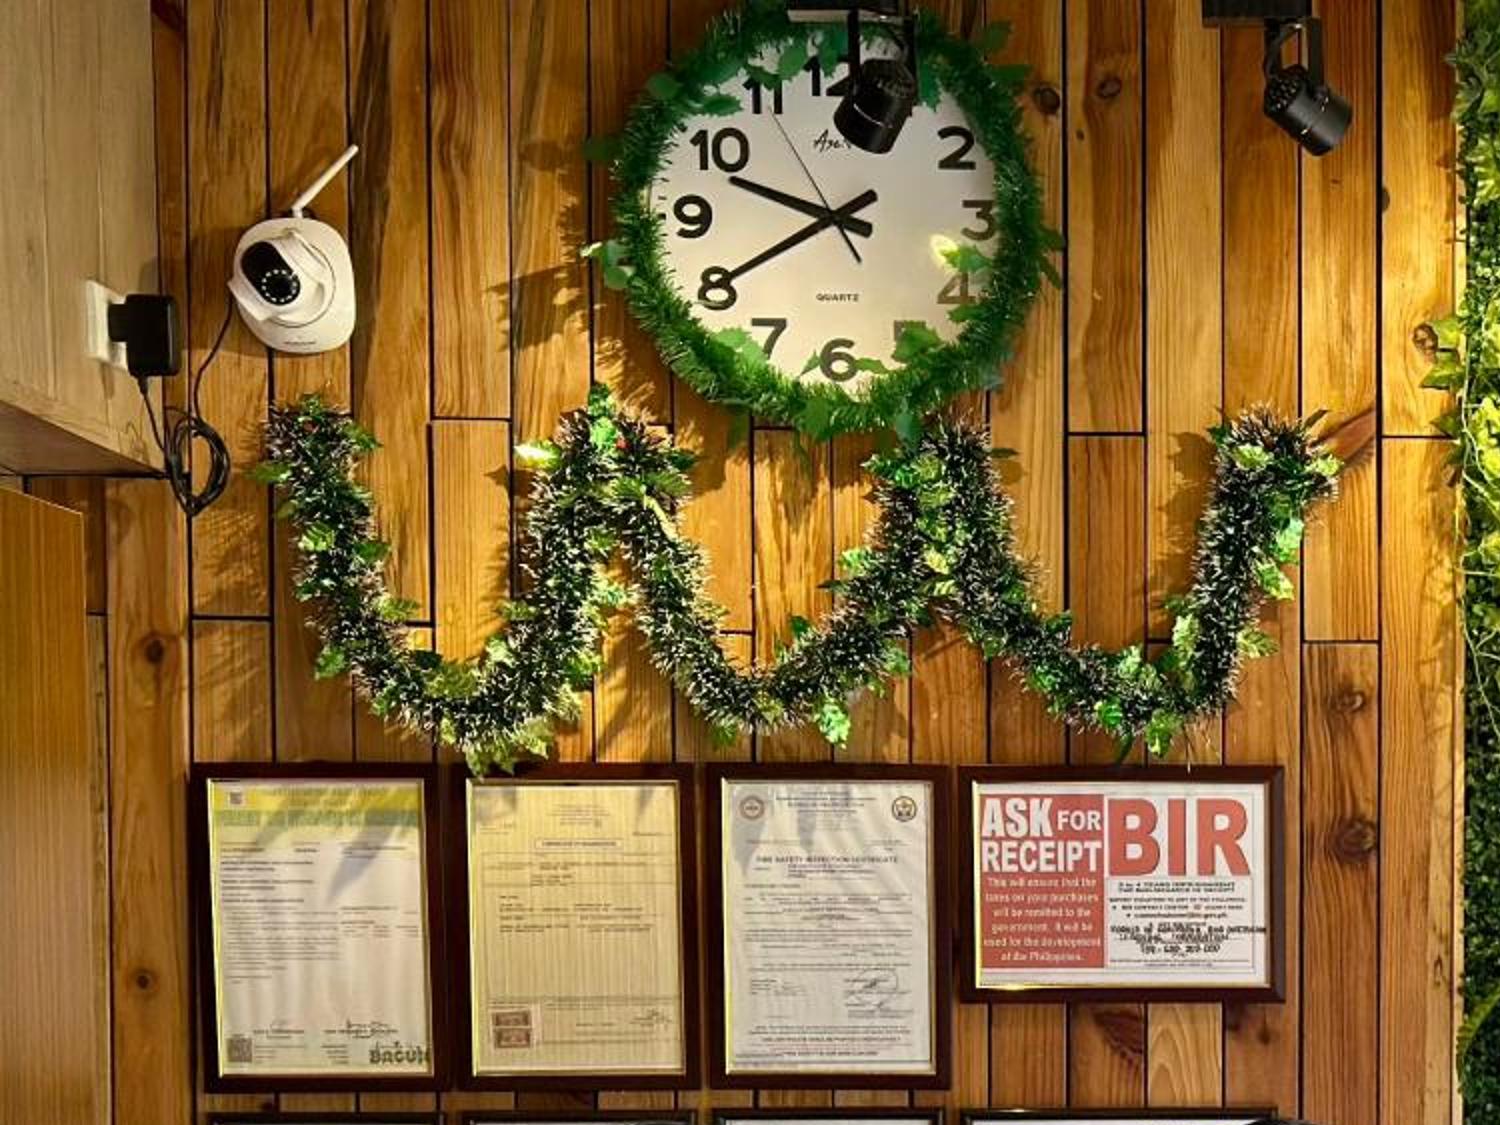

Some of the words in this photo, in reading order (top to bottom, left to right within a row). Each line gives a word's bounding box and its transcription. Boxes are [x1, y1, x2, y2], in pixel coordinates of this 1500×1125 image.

[690, 127, 750, 173] 10
[937, 127, 976, 170] 2
[673, 194, 713, 239] 9
[961, 199, 996, 241] 3
[697, 266, 738, 311] 8
[936, 272, 976, 305] 4
[751, 318, 788, 361] 7
[817, 338, 859, 382] 6
[981, 798, 1054, 838] ASK
[1057, 810, 1102, 831] FOR
[1107, 797, 1252, 877] BIR
[981, 840, 1103, 873] RECEIPT
